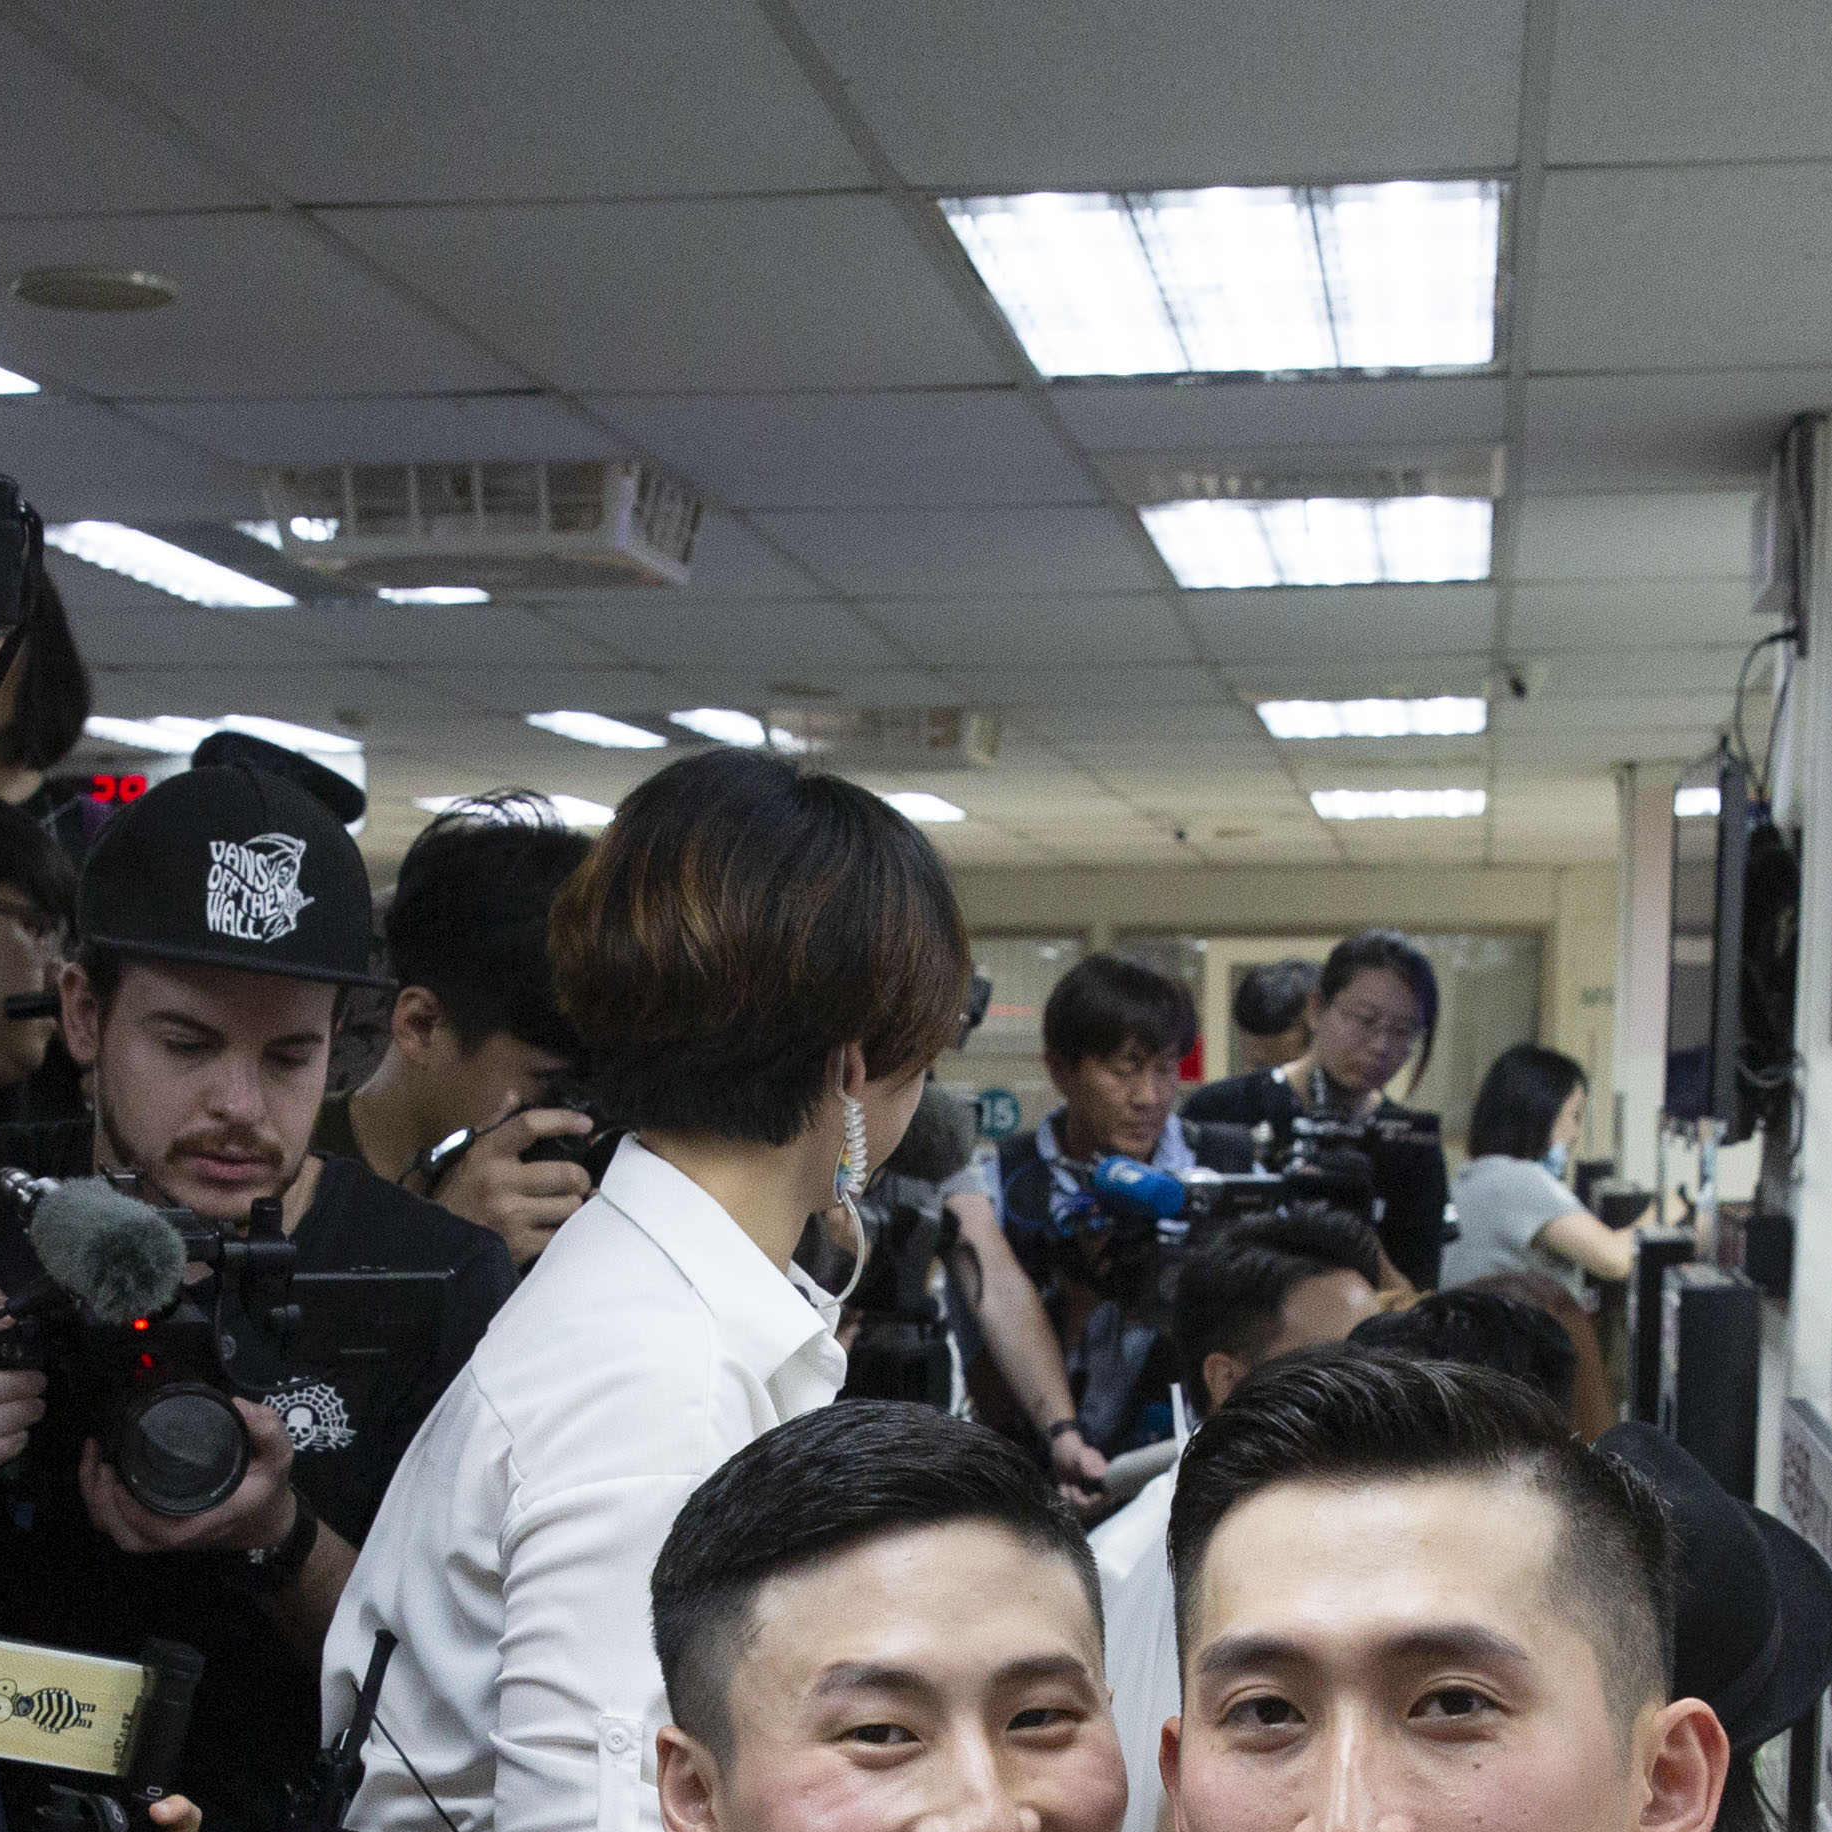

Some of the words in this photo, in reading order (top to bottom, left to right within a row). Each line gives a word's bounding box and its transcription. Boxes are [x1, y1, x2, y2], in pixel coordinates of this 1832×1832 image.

[207, 863, 241, 897] OFF
[241, 884, 279, 919] THE
[209, 840, 269, 892] VANS
[207, 891, 263, 940] WALL
